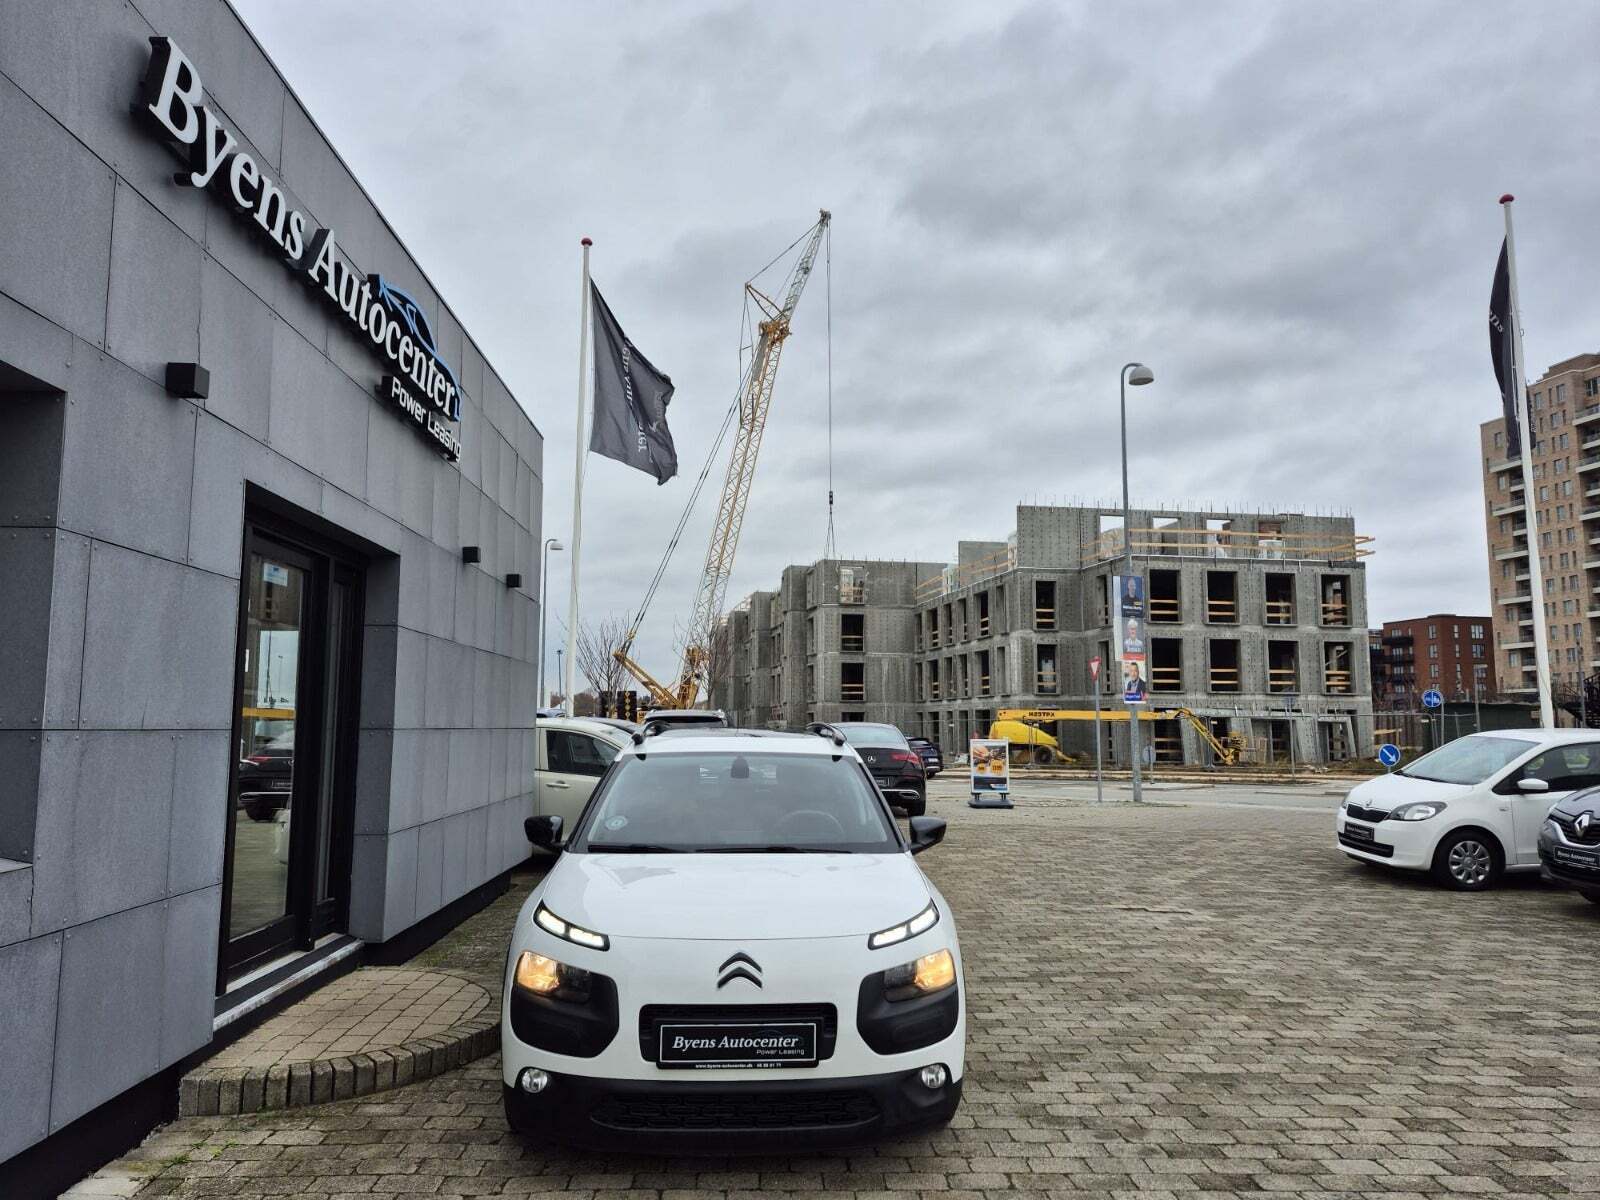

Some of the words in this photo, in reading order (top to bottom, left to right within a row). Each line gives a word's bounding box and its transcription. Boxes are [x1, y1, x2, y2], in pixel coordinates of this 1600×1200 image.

[148, 36, 307, 261] Byens
[308, 228, 456, 417] Autocenter
[391, 376, 426, 424] Power
[428, 410, 462, 463] Leasing
[672, 1036, 717, 1052] Byens
[717, 1035, 799, 1049] Autocenter
